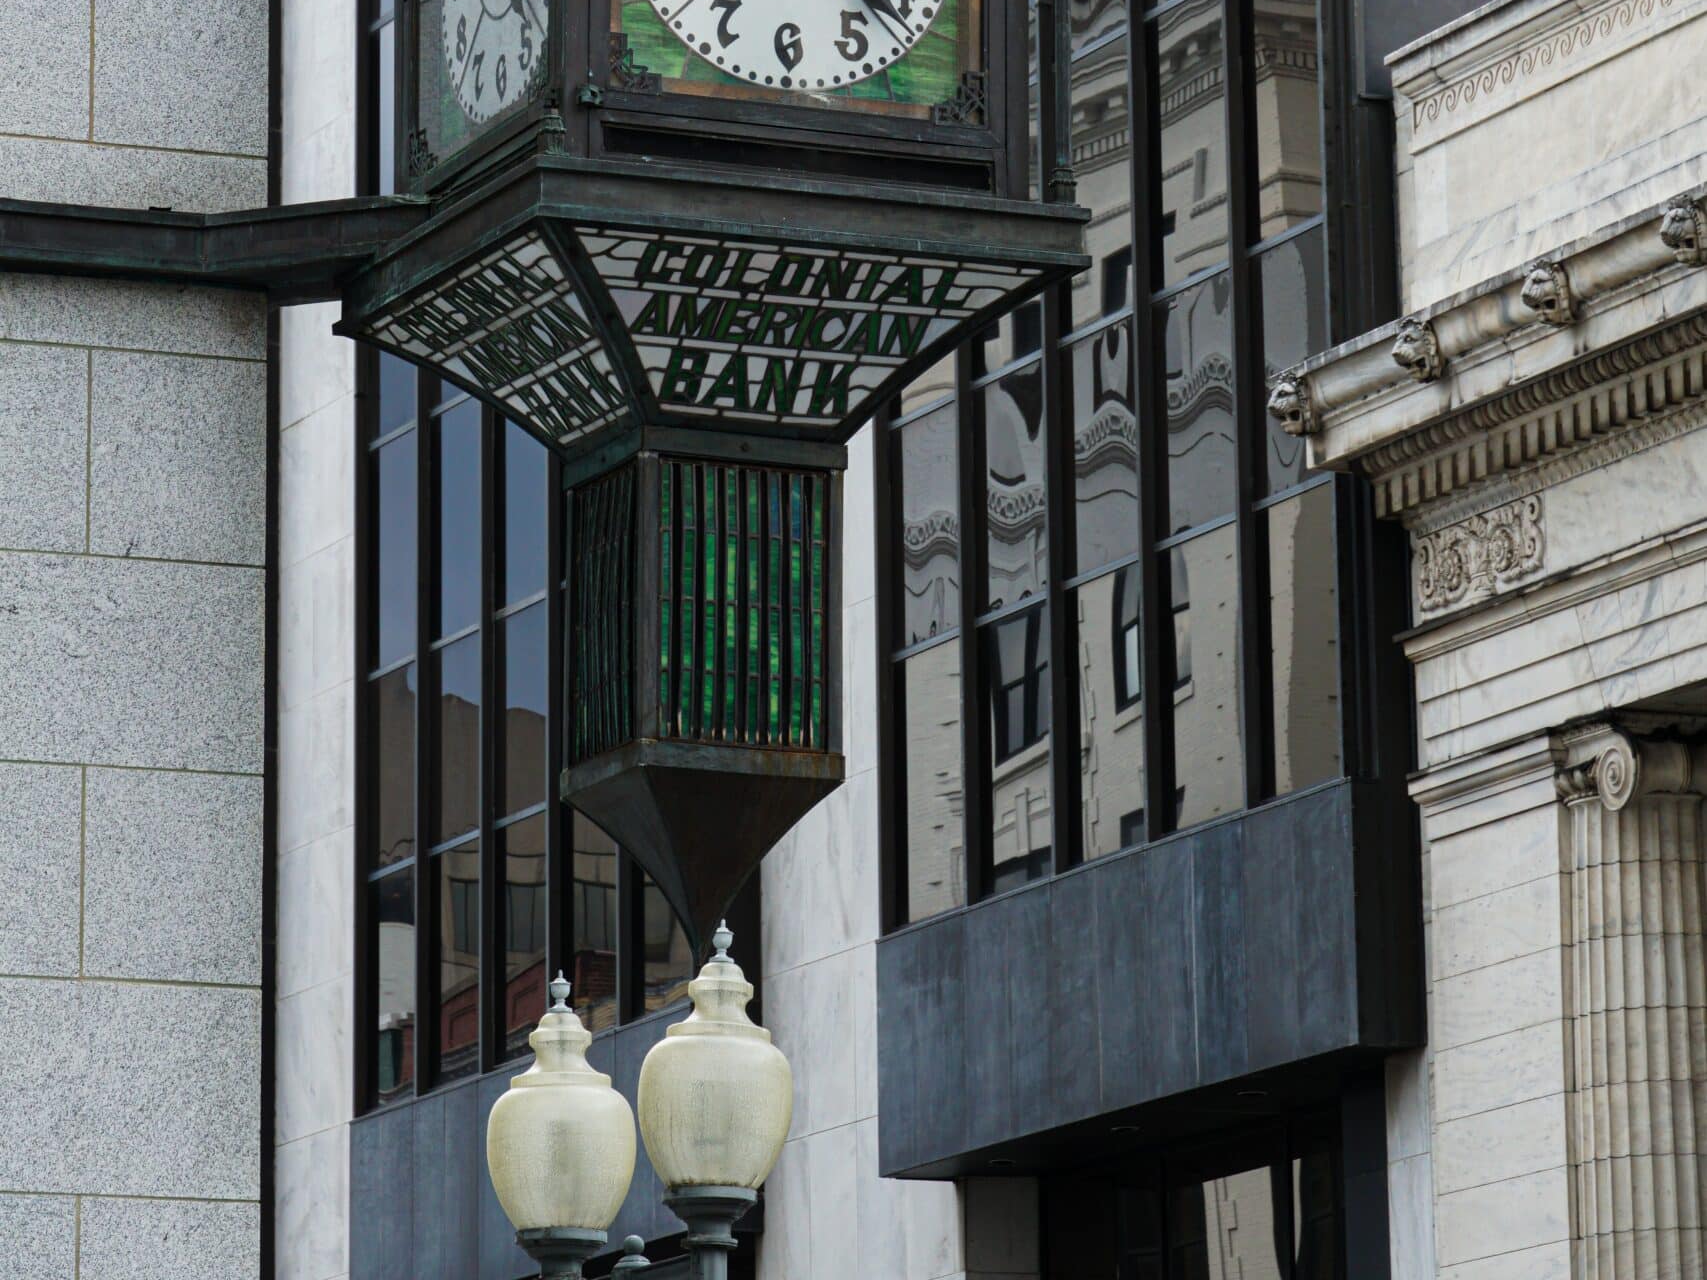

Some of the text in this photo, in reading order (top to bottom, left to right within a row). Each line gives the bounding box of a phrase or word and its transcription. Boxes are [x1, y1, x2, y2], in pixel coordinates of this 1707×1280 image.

[455, 13, 468, 64] 8
[518, 19, 533, 72] 5
[773, 21, 805, 74] 6
[833, 9, 870, 63] 5
[471, 50, 486, 103] 7
[495, 53, 508, 103] 6
[635, 242, 976, 311] COLONIAL
[629, 290, 929, 357] AMERICAN
[658, 345, 851, 415] BANK
